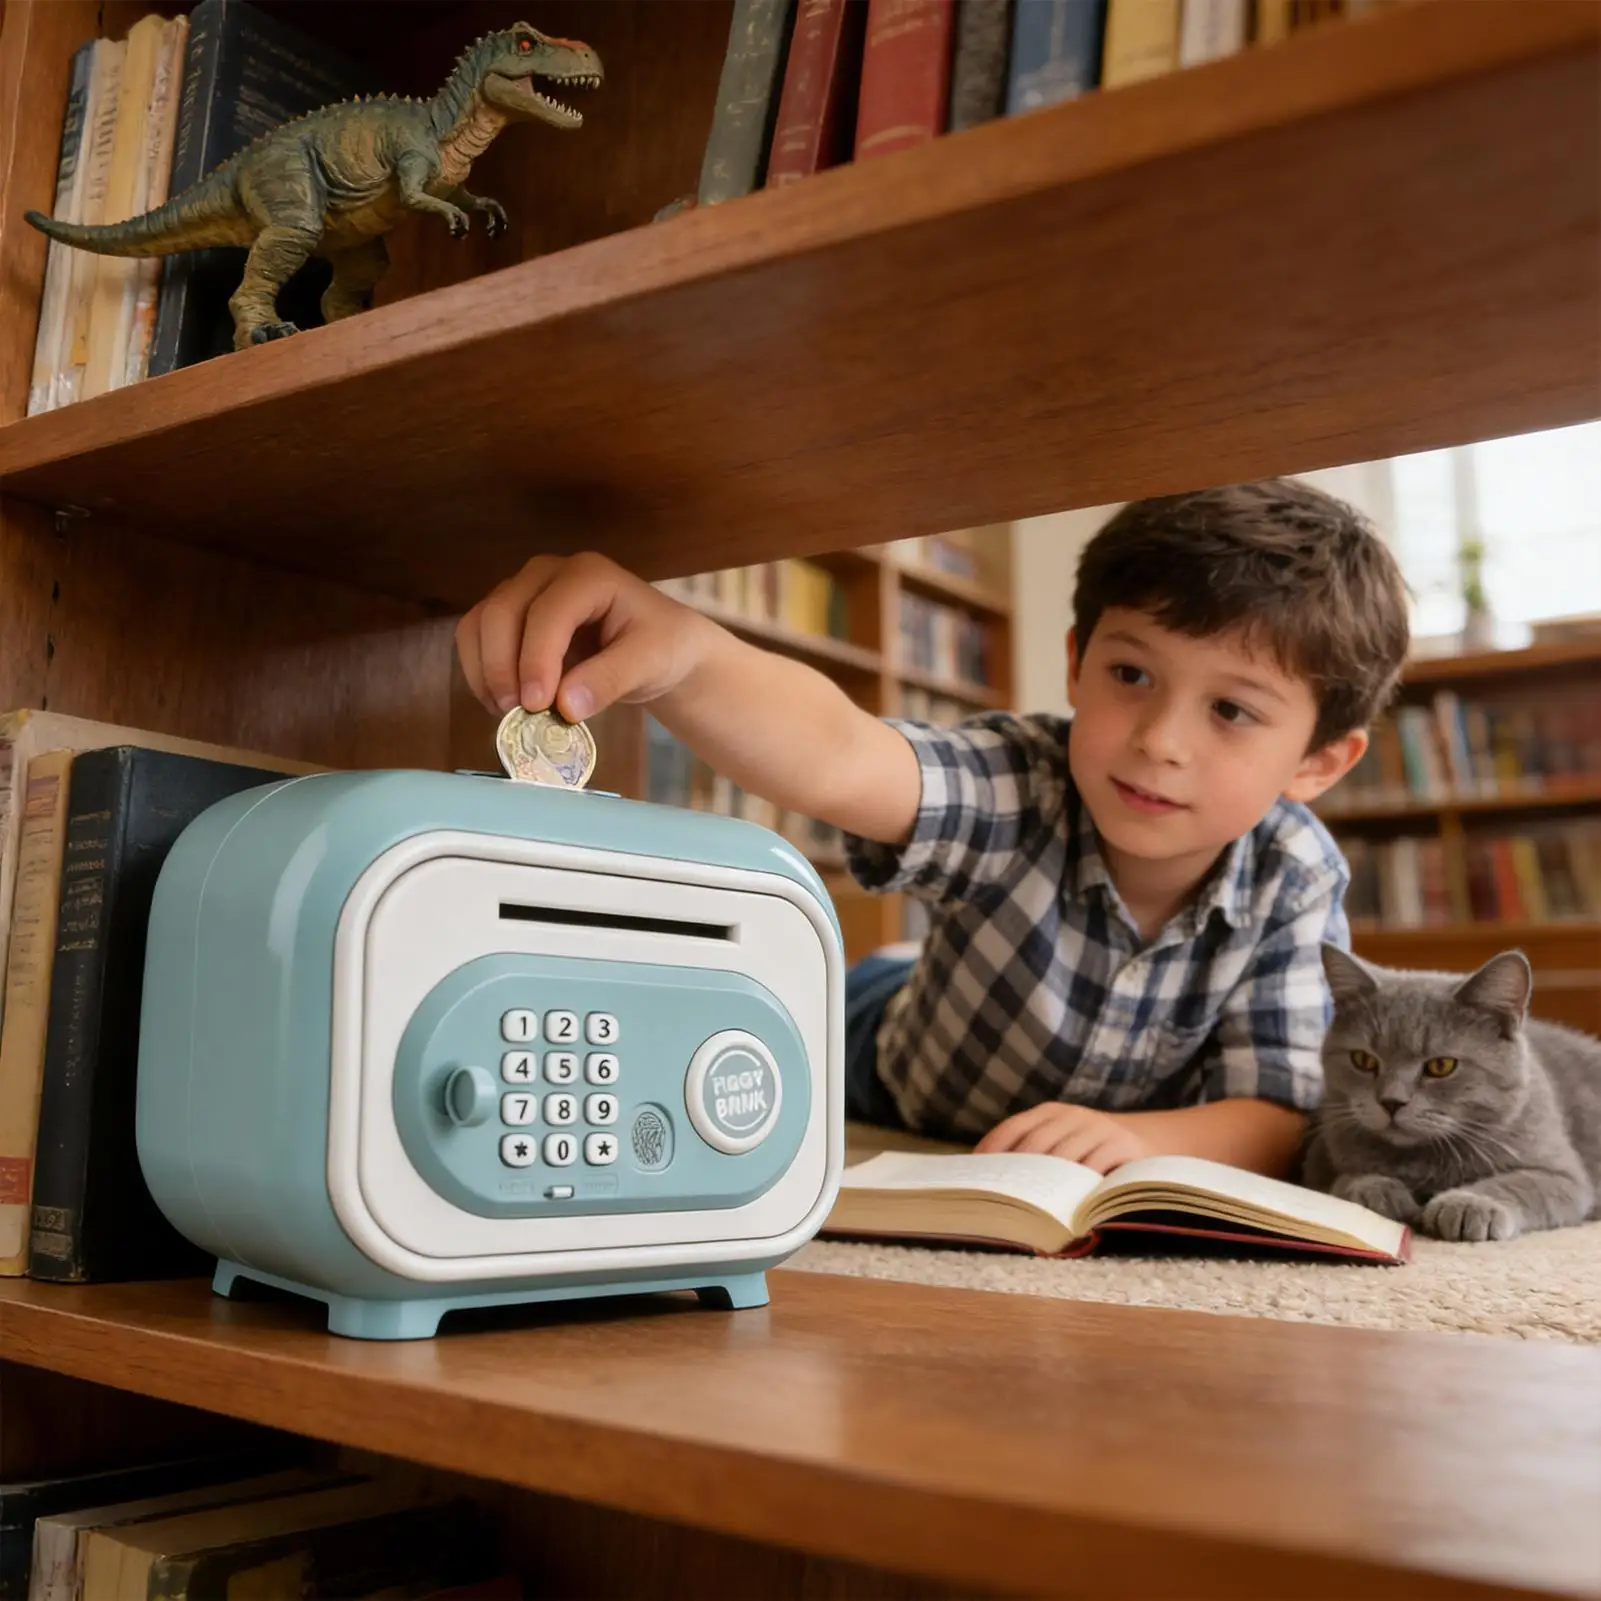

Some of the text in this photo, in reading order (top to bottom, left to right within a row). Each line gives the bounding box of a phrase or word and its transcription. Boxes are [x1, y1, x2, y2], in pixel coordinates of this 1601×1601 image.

[520, 1016, 611, 1039] 1 2 3
[515, 1057, 611, 1080] 4 5 6
[515, 1099, 611, 1120] 7 8 9
[557, 1139, 569, 1161] 0
